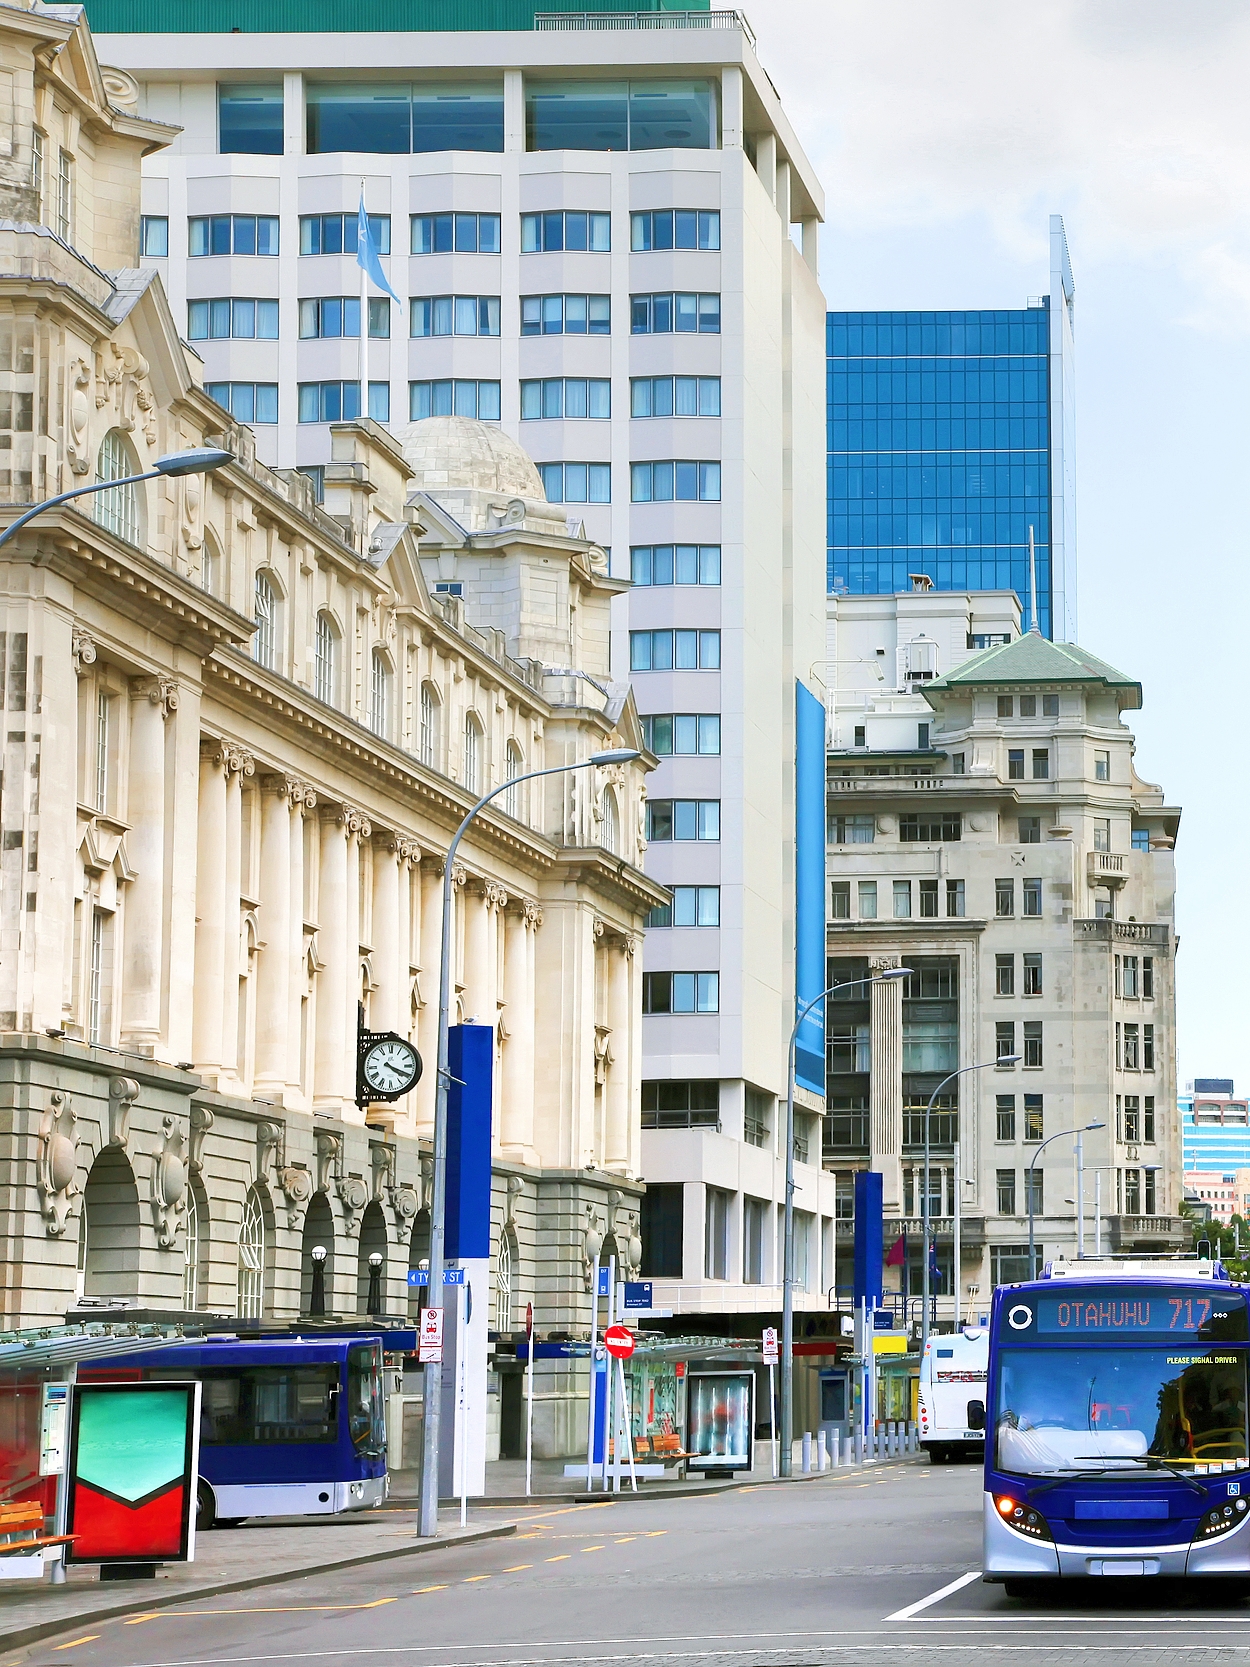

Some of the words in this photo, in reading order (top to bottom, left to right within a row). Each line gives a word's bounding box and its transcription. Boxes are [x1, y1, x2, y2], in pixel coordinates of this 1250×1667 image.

[418, 1271, 446, 1282] TYR
[449, 1272, 460, 1282] ST
[1057, 1302, 1150, 1327] OTAHUHU
[1168, 1298, 1211, 1328] 717
[1166, 1357, 1190, 1365] PLEASE
[1191, 1356, 1213, 1364] SIGNAL
[1214, 1356, 1238, 1364] DRIVER
